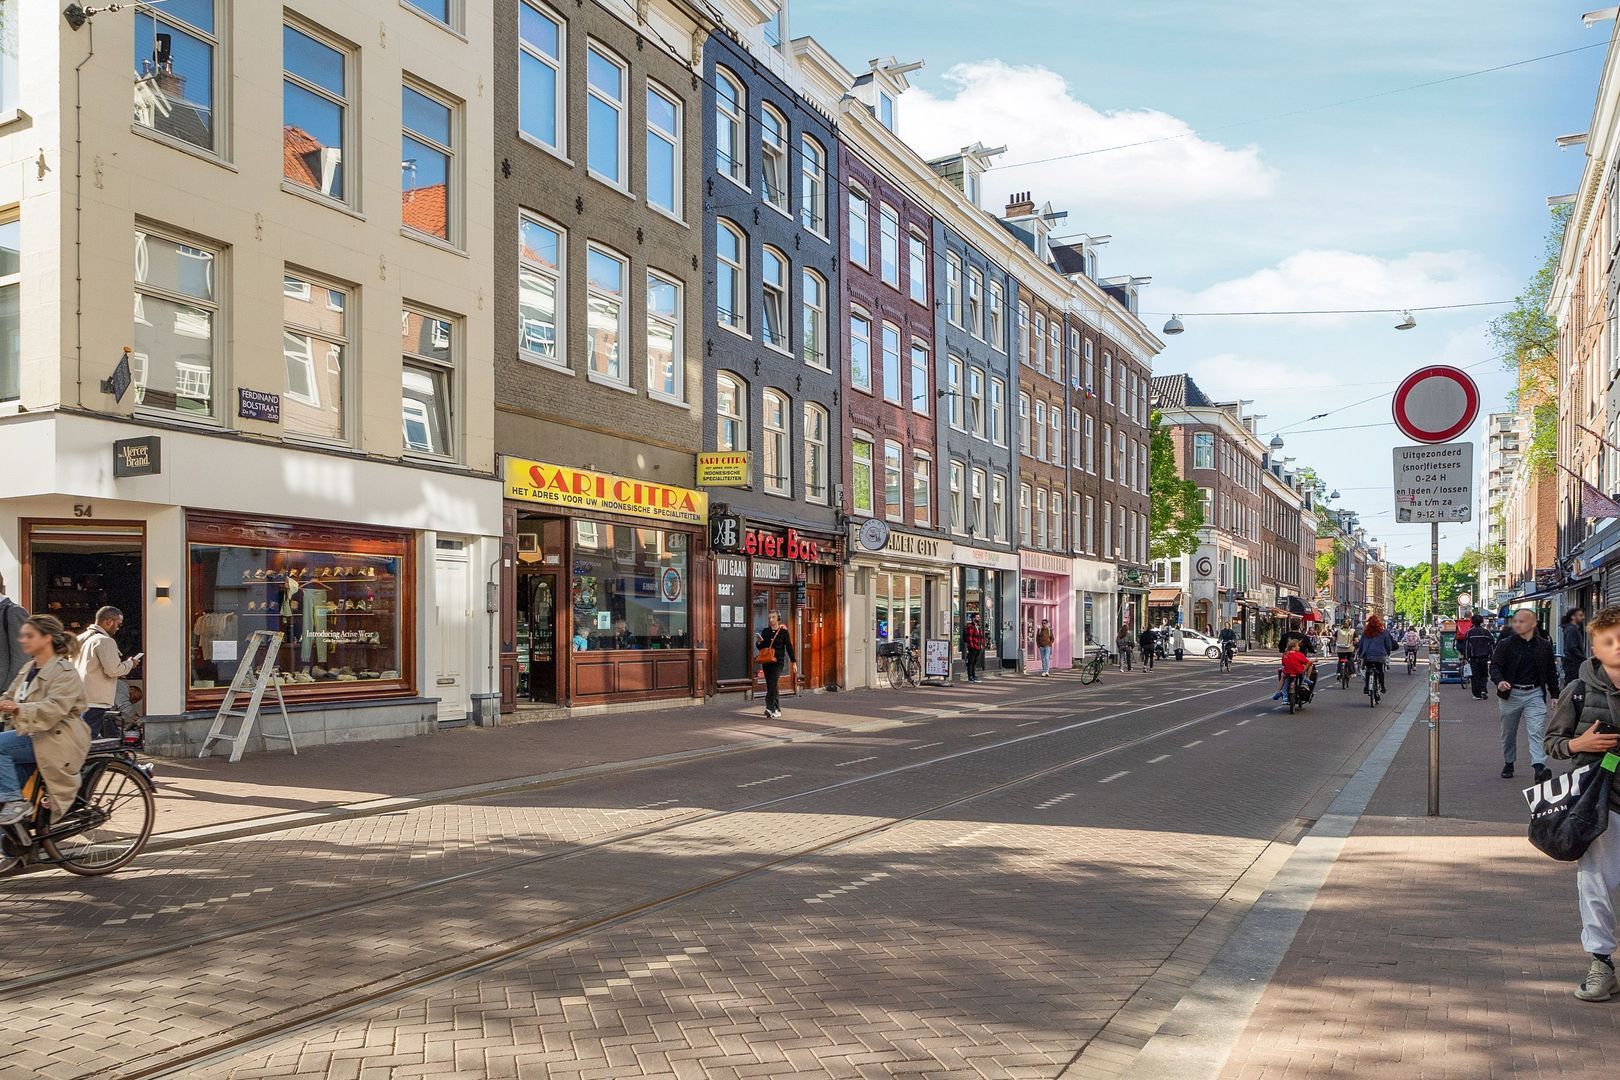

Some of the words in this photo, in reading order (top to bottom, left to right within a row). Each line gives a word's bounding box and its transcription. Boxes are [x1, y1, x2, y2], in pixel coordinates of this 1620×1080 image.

[242, 390, 278, 403] FERDINAND
[242, 400, 279, 413] BOLSTRAAT
[123, 446, 148, 457] Mercer
[1403, 449, 1462, 460] Uitgezonderd
[721, 456, 747, 464] CITRA
[1402, 462, 1461, 472] (snor)fietsers
[1415, 474, 1437, 482] 0-24
[529, 465, 605, 498] SARI
[613, 480, 696, 512] CITRA
[1409, 487, 1431, 495] laden
[1440, 486, 1468, 494] lossen
[512, 487, 529, 496] HET
[532, 490, 559, 500] ADRES
[562, 494, 583, 504] VOOR
[586, 498, 598, 506] UW
[601, 500, 651, 513] INDONESISCHE
[653, 508, 700, 520] SPECIALITEITEN
[1425, 498, 1440, 506] t/m
[74, 504, 92, 518] 54
[740, 529, 784, 558] eter
[787, 528, 817, 561] Bas
[886, 532, 915, 554] AMEN
[917, 538, 940, 558] CITY
[729, 560, 747, 577] GAAN
[306, 629, 340, 639] Introducing
[341, 629, 358, 638] Active
[358, 629, 374, 638] Wear
